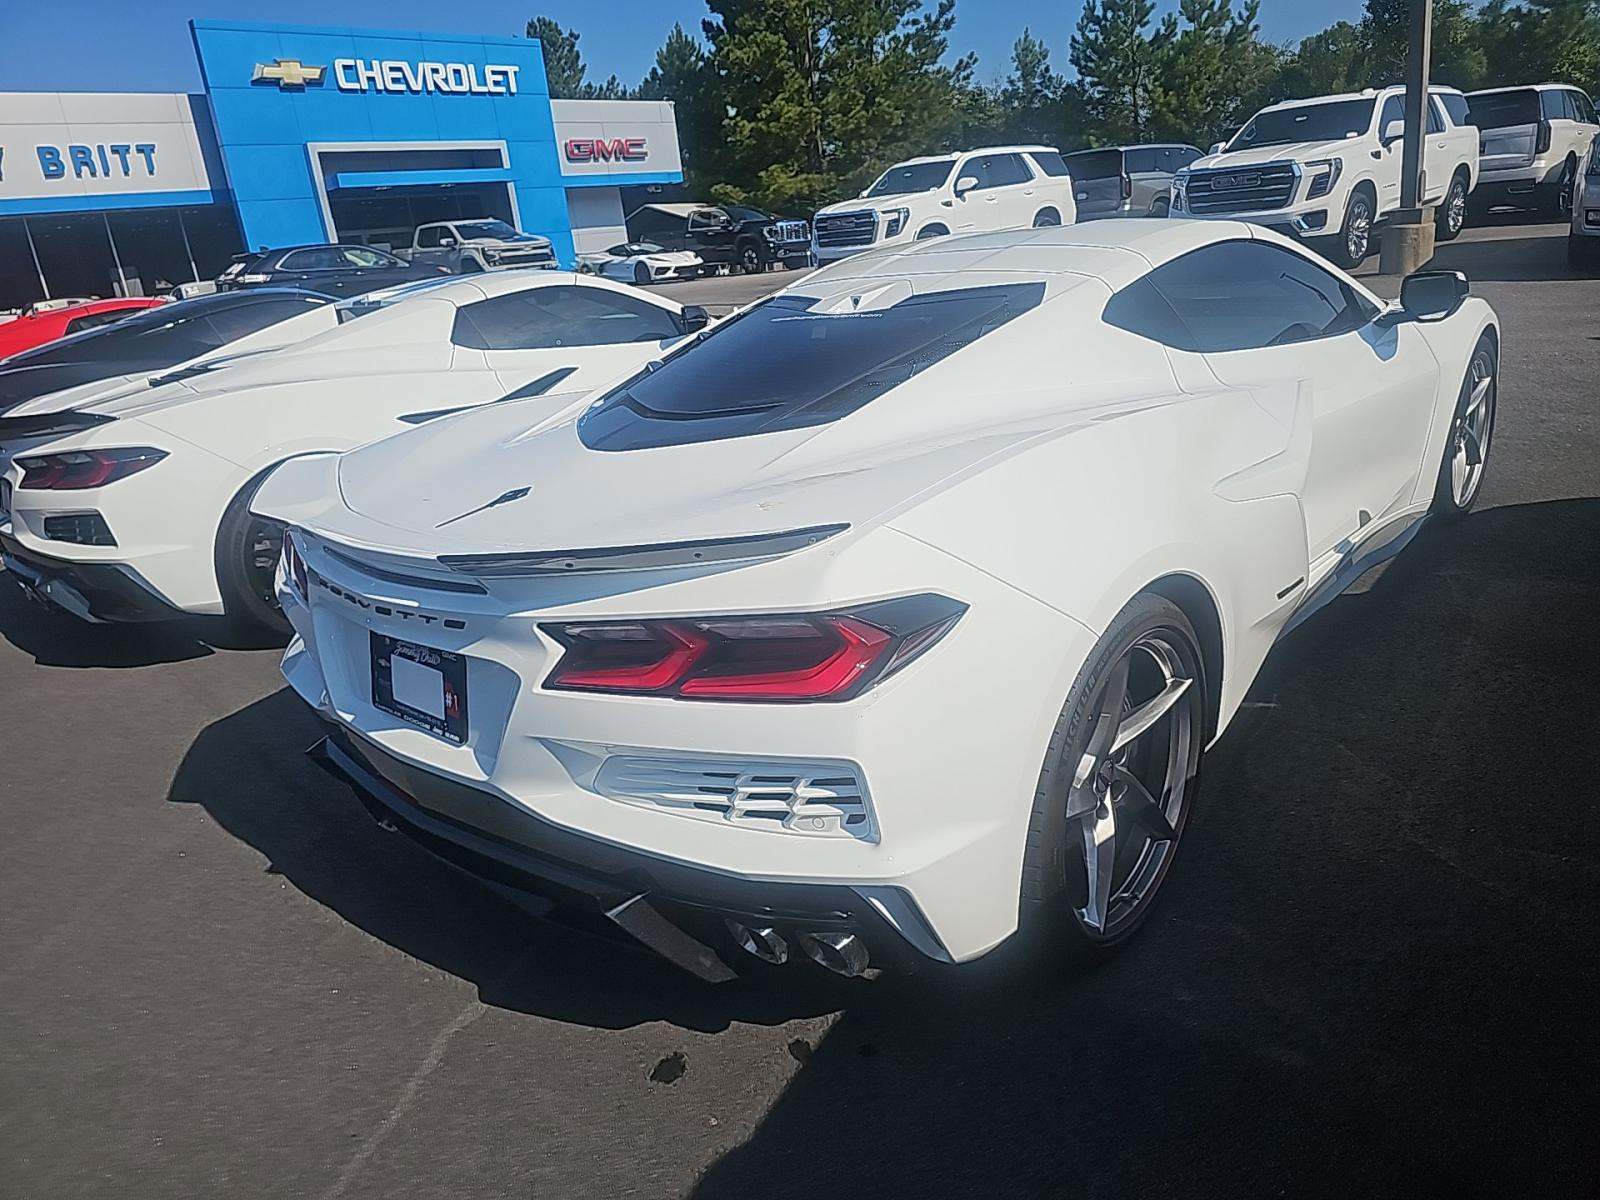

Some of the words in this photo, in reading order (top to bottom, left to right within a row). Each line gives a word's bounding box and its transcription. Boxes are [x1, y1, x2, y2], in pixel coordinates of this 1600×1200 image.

[334, 58, 519, 94] CHEVROLET
[36, 144, 156, 179] BRITT
[565, 139, 648, 163] GMC
